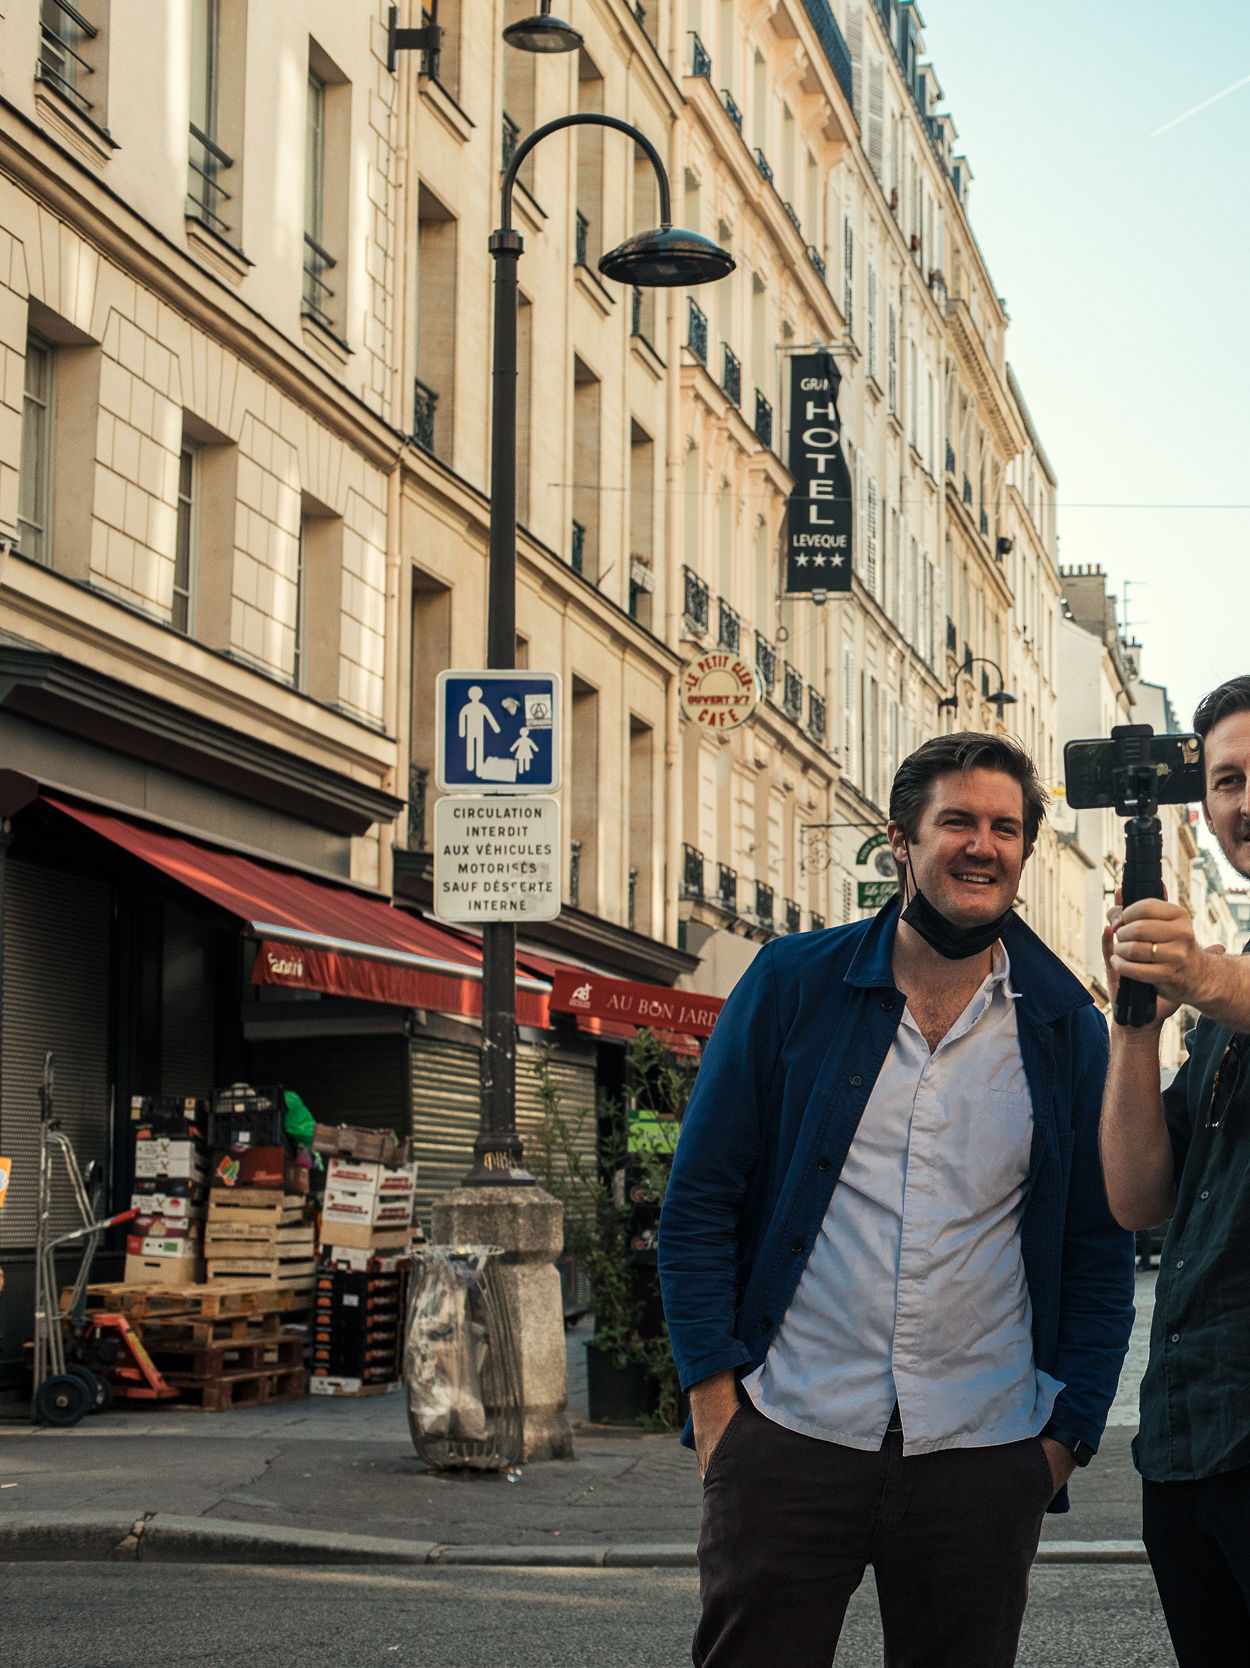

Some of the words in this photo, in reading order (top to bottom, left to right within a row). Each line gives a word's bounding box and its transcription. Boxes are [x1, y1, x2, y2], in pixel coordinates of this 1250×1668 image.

[802, 400, 840, 524] HOTEL
[792, 534, 848, 549] LEVEQUE
[685, 672, 700, 687] LE
[697, 655, 729, 673] PETIT
[731, 661, 753, 687] CLER
[687, 695, 729, 704] OUVERT
[698, 708, 739, 727] CAFE
[453, 807, 542, 819] CIRCULATION
[466, 826, 528, 837] INTERDIT
[443, 844, 469, 855] AUX
[476, 842, 552, 855] VÉHICULES
[443, 881, 478, 893] SAUF
[468, 900, 526, 911] INTERNE
[606, 994, 633, 1011] AU
[638, 998, 675, 1019] BON
